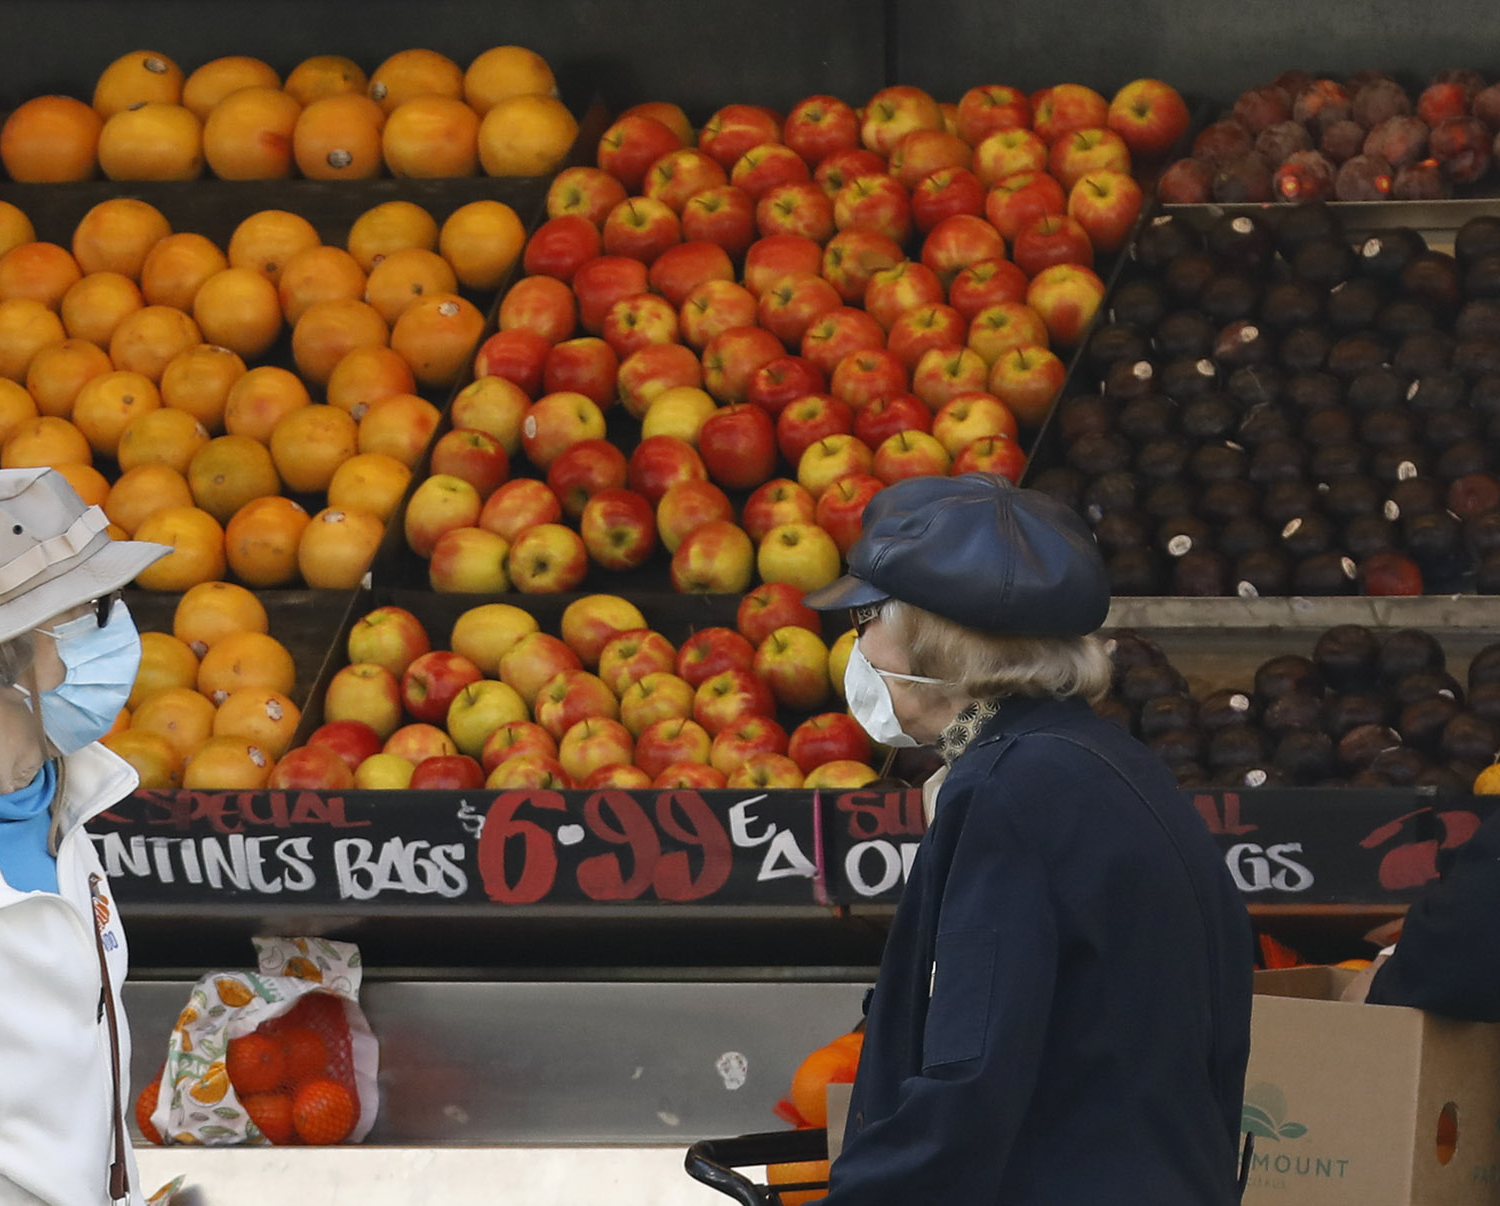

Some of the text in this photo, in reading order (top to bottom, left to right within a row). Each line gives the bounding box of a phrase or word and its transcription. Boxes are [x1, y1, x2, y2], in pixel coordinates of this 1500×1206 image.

[134, 789, 372, 834] SPECIAL
[334, 836, 468, 900] BAGS
[729, 793, 819, 881] EA
